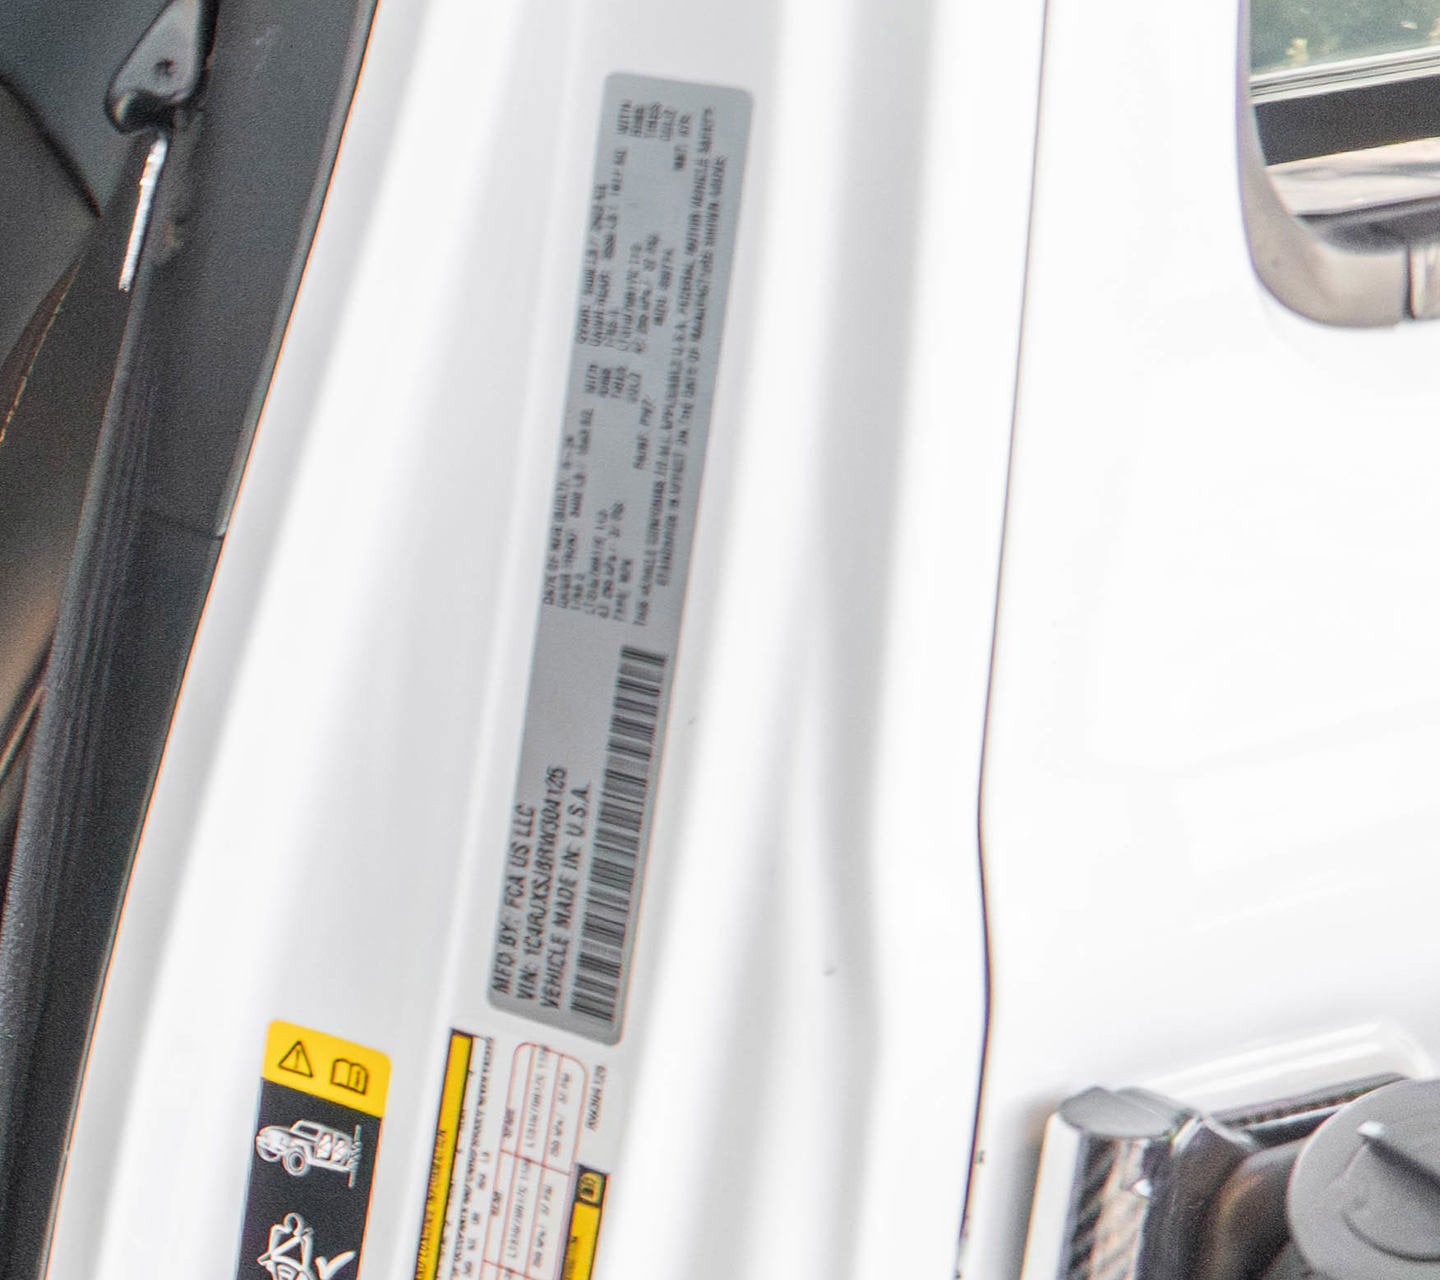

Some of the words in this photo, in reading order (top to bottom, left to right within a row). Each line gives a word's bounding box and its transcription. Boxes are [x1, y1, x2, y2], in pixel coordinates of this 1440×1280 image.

[513, 803, 534, 838] LLC
[510, 841, 530, 870] US
[504, 874, 526, 909] FCA
[554, 877, 577, 929] MADE
[516, 964, 538, 1002] VIN:
[541, 936, 569, 1009] VEHICLE
